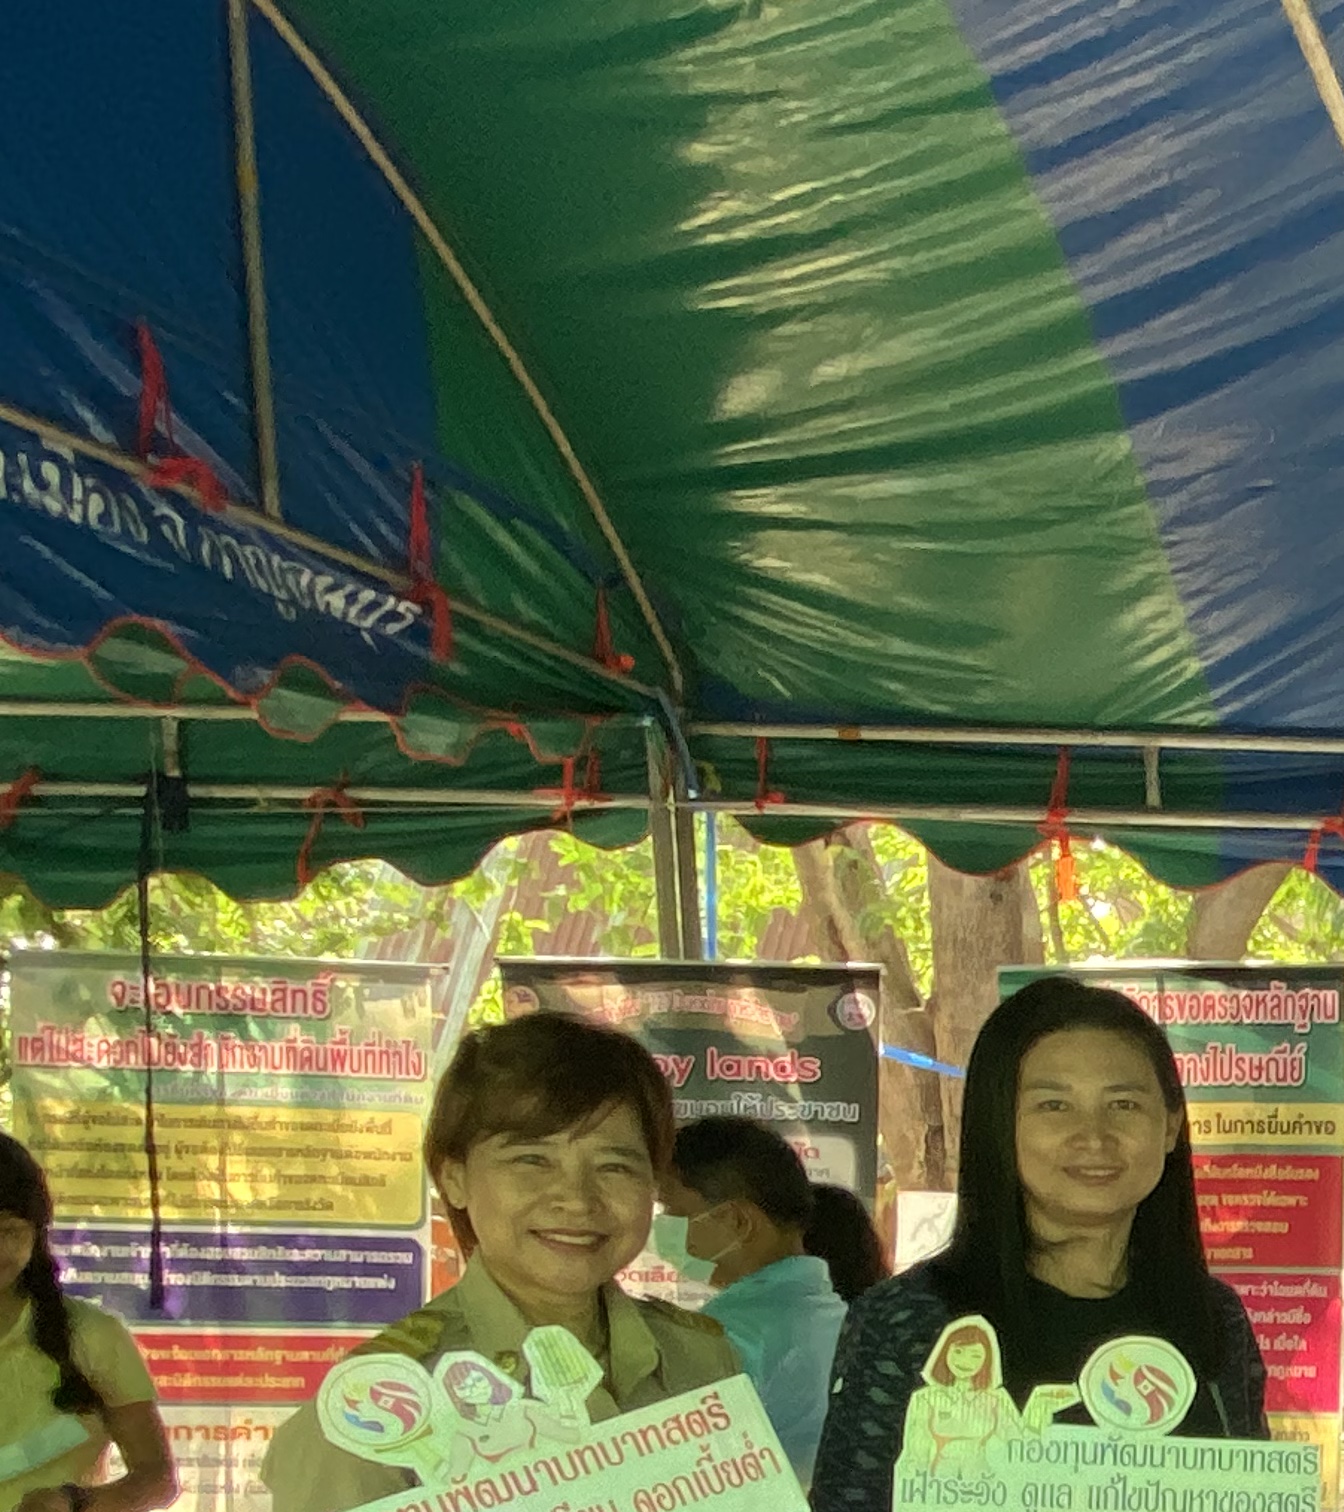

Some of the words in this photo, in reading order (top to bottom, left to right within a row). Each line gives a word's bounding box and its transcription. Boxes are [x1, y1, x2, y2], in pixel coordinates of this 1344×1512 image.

[707, 1047, 820, 1083] lands
[1216, 1109, 1336, 1135] ในการยื่นคำขอ
[1007, 1436, 1320, 1476] กองทุนพัฒนาบทบาทสตรี
